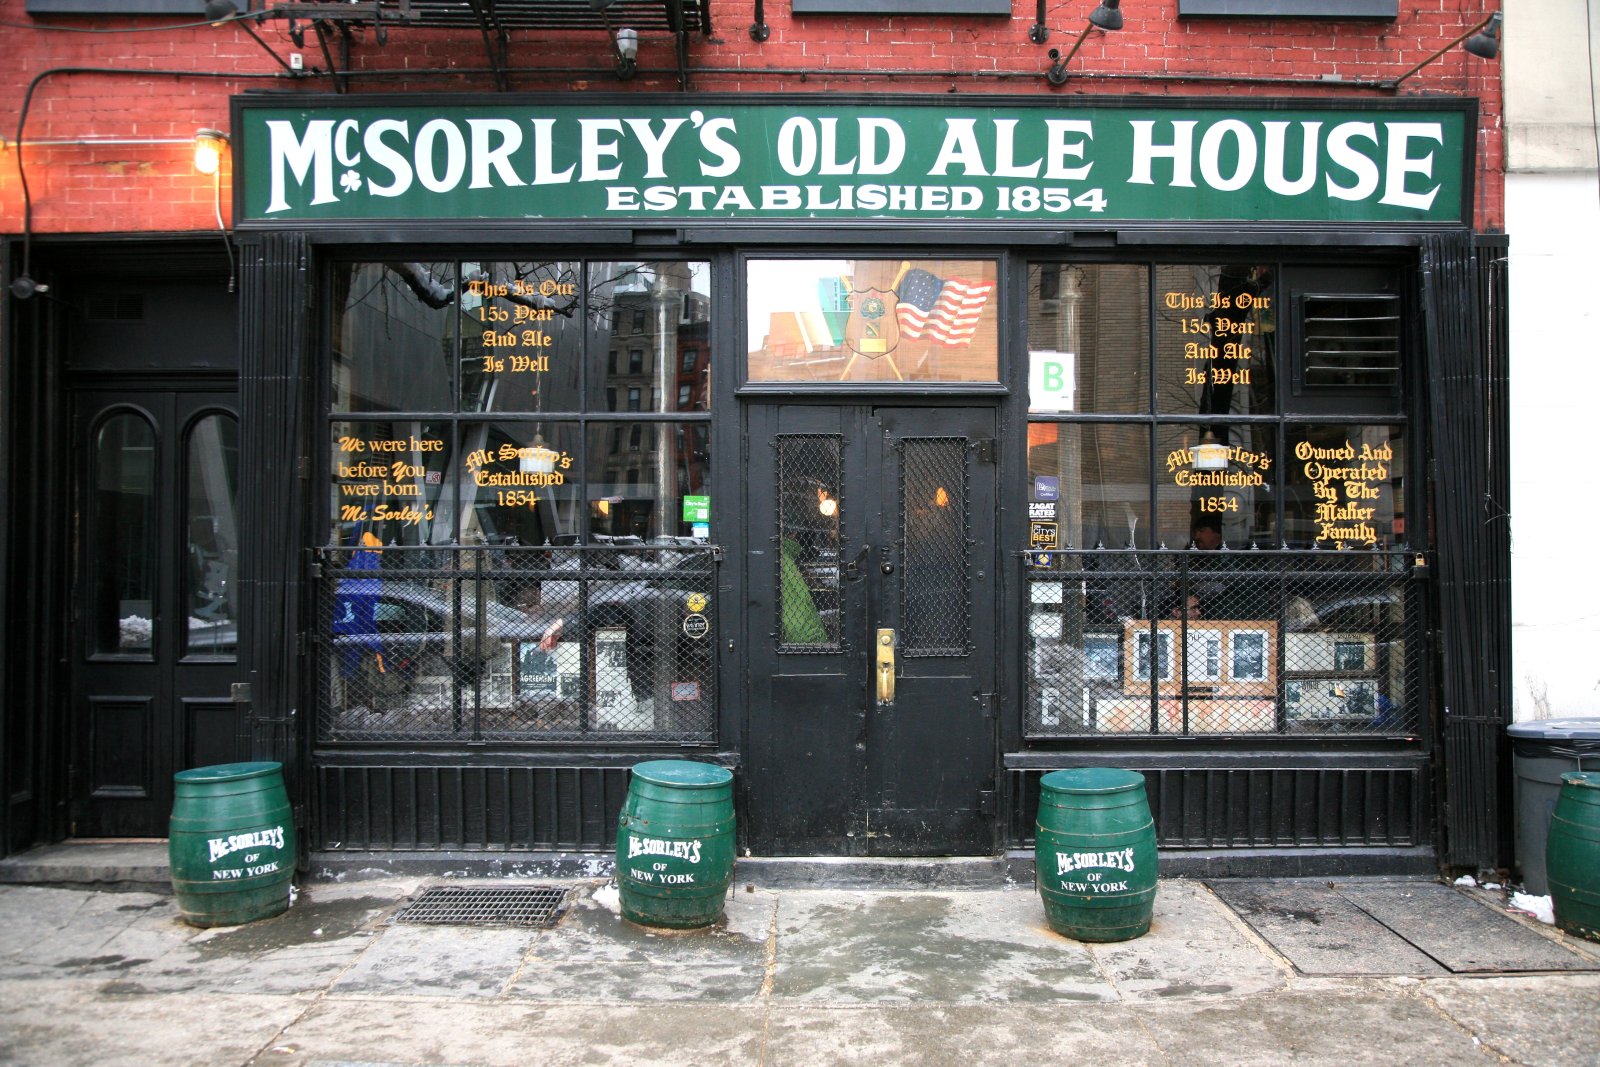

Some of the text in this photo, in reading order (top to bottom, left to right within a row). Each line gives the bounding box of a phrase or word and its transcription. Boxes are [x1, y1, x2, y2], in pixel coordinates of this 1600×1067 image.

[777, 116, 906, 177] OLD
[926, 118, 1094, 181] ALE
[1126, 118, 1443, 211] HOUSE
[605, 183, 1108, 215] ESTABLISHED 1854
[468, 279, 576, 299] This Is Our
[1165, 292, 1270, 311] This Is Our
[515, 304, 554, 325] Year
[1216, 317, 1256, 337] Year
[482, 329, 552, 347] And Ale
[1184, 342, 1252, 360] And Ale
[483, 355, 549, 373] Is Well
[1043, 361, 1064, 392] B
[1184, 367, 1251, 385] Is Well
[338, 436, 443, 452] We were here
[1295, 441, 1393, 462] Owned And
[466, 450, 496, 473] Mc
[1166, 448, 1195, 474] Mc
[339, 460, 388, 478] before
[391, 461, 425, 482] You
[474, 469, 564, 489] Established
[1174, 470, 1263, 489] Established
[1304, 462, 1388, 483] Operated
[341, 484, 379, 496] were
[497, 490, 536, 507] 1854
[1313, 478, 1384, 504] By The
[1199, 496, 1238, 513] 1854
[341, 504, 434, 526] Mc Sorley's
[1315, 522, 1377, 545] Family
[244, 853, 260, 863] OF
[652, 862, 668, 872] OF
[213, 861, 279, 879] NEW YORK
[631, 868, 695, 884] NEW YORK
[1087, 873, 1102, 882] OF
[1061, 881, 1128, 893] NEW YORK
